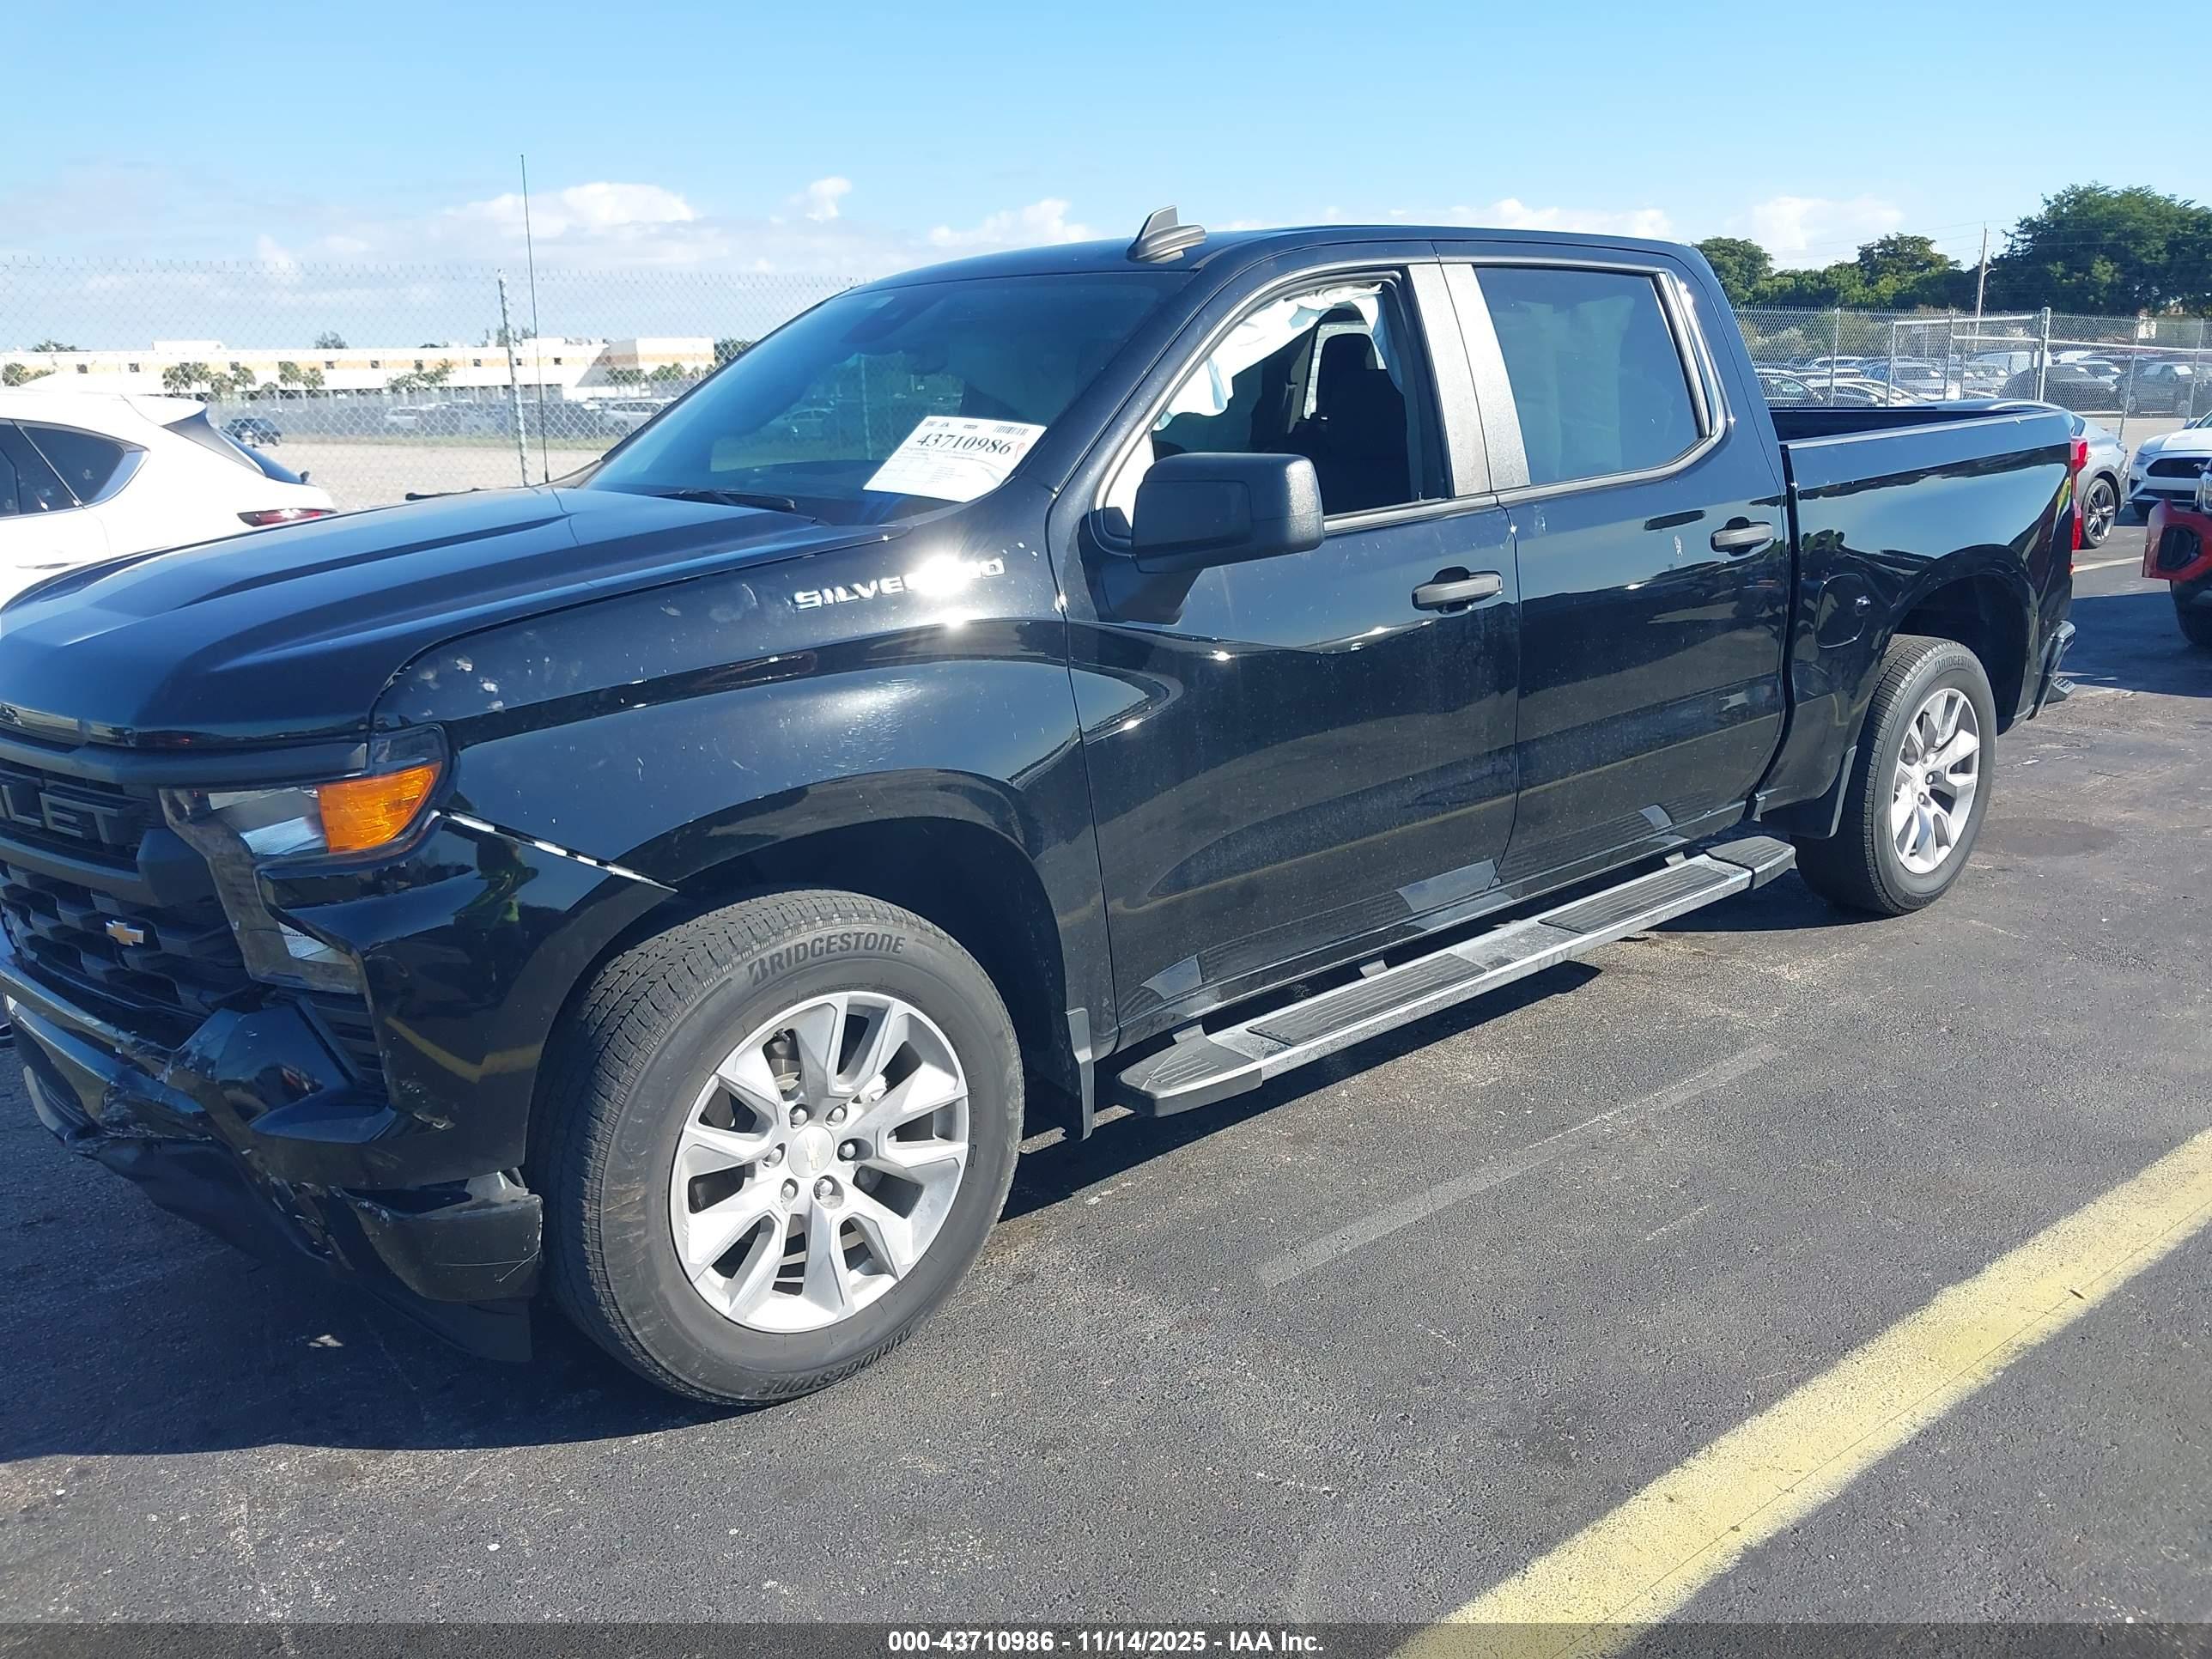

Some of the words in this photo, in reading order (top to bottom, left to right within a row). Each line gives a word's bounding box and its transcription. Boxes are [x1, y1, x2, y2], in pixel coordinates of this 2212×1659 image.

[916, 433, 1015, 455] 43710986
[793, 557, 1006, 612] SILVEO
[0, 783, 118, 845] LET
[747, 932, 906, 987] BRIDGESTONE
